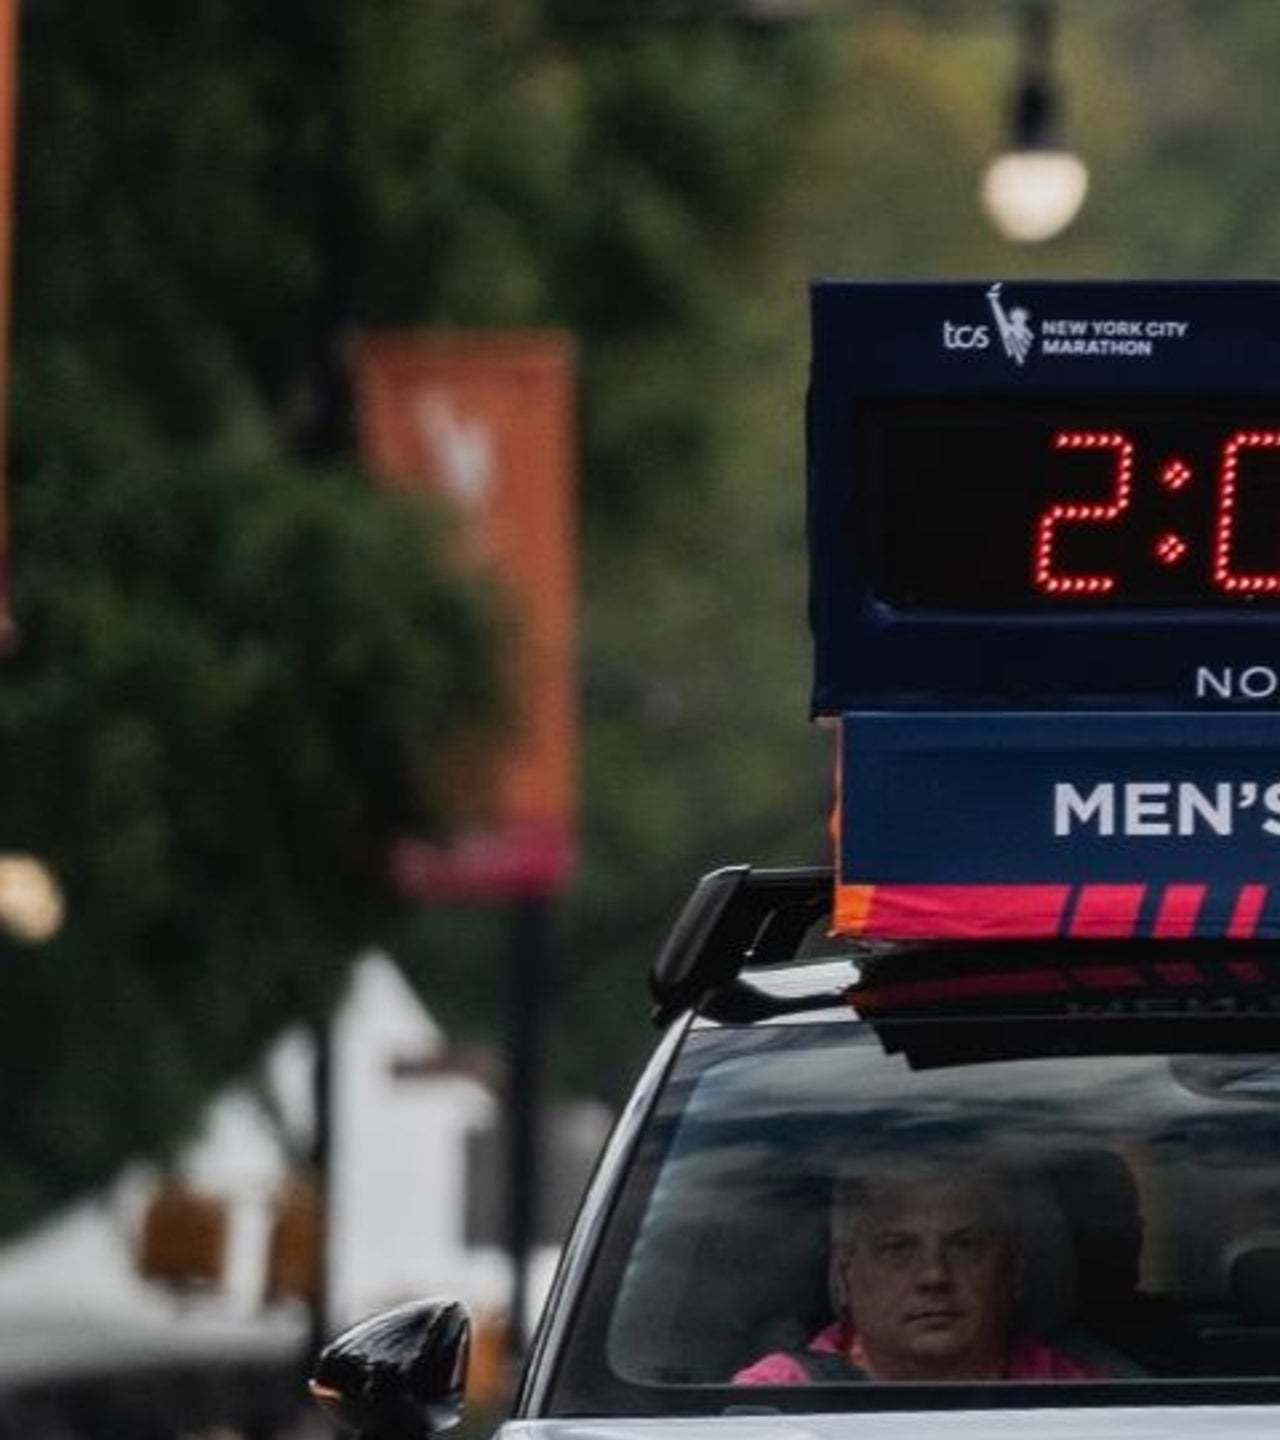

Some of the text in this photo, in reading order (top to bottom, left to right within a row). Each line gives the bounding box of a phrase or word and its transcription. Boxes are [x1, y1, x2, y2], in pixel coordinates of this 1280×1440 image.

[943, 321, 990, 350] tcs
[1042, 319, 1188, 338] NEW YORK CITY
[1042, 339, 1152, 356] MARATHON
